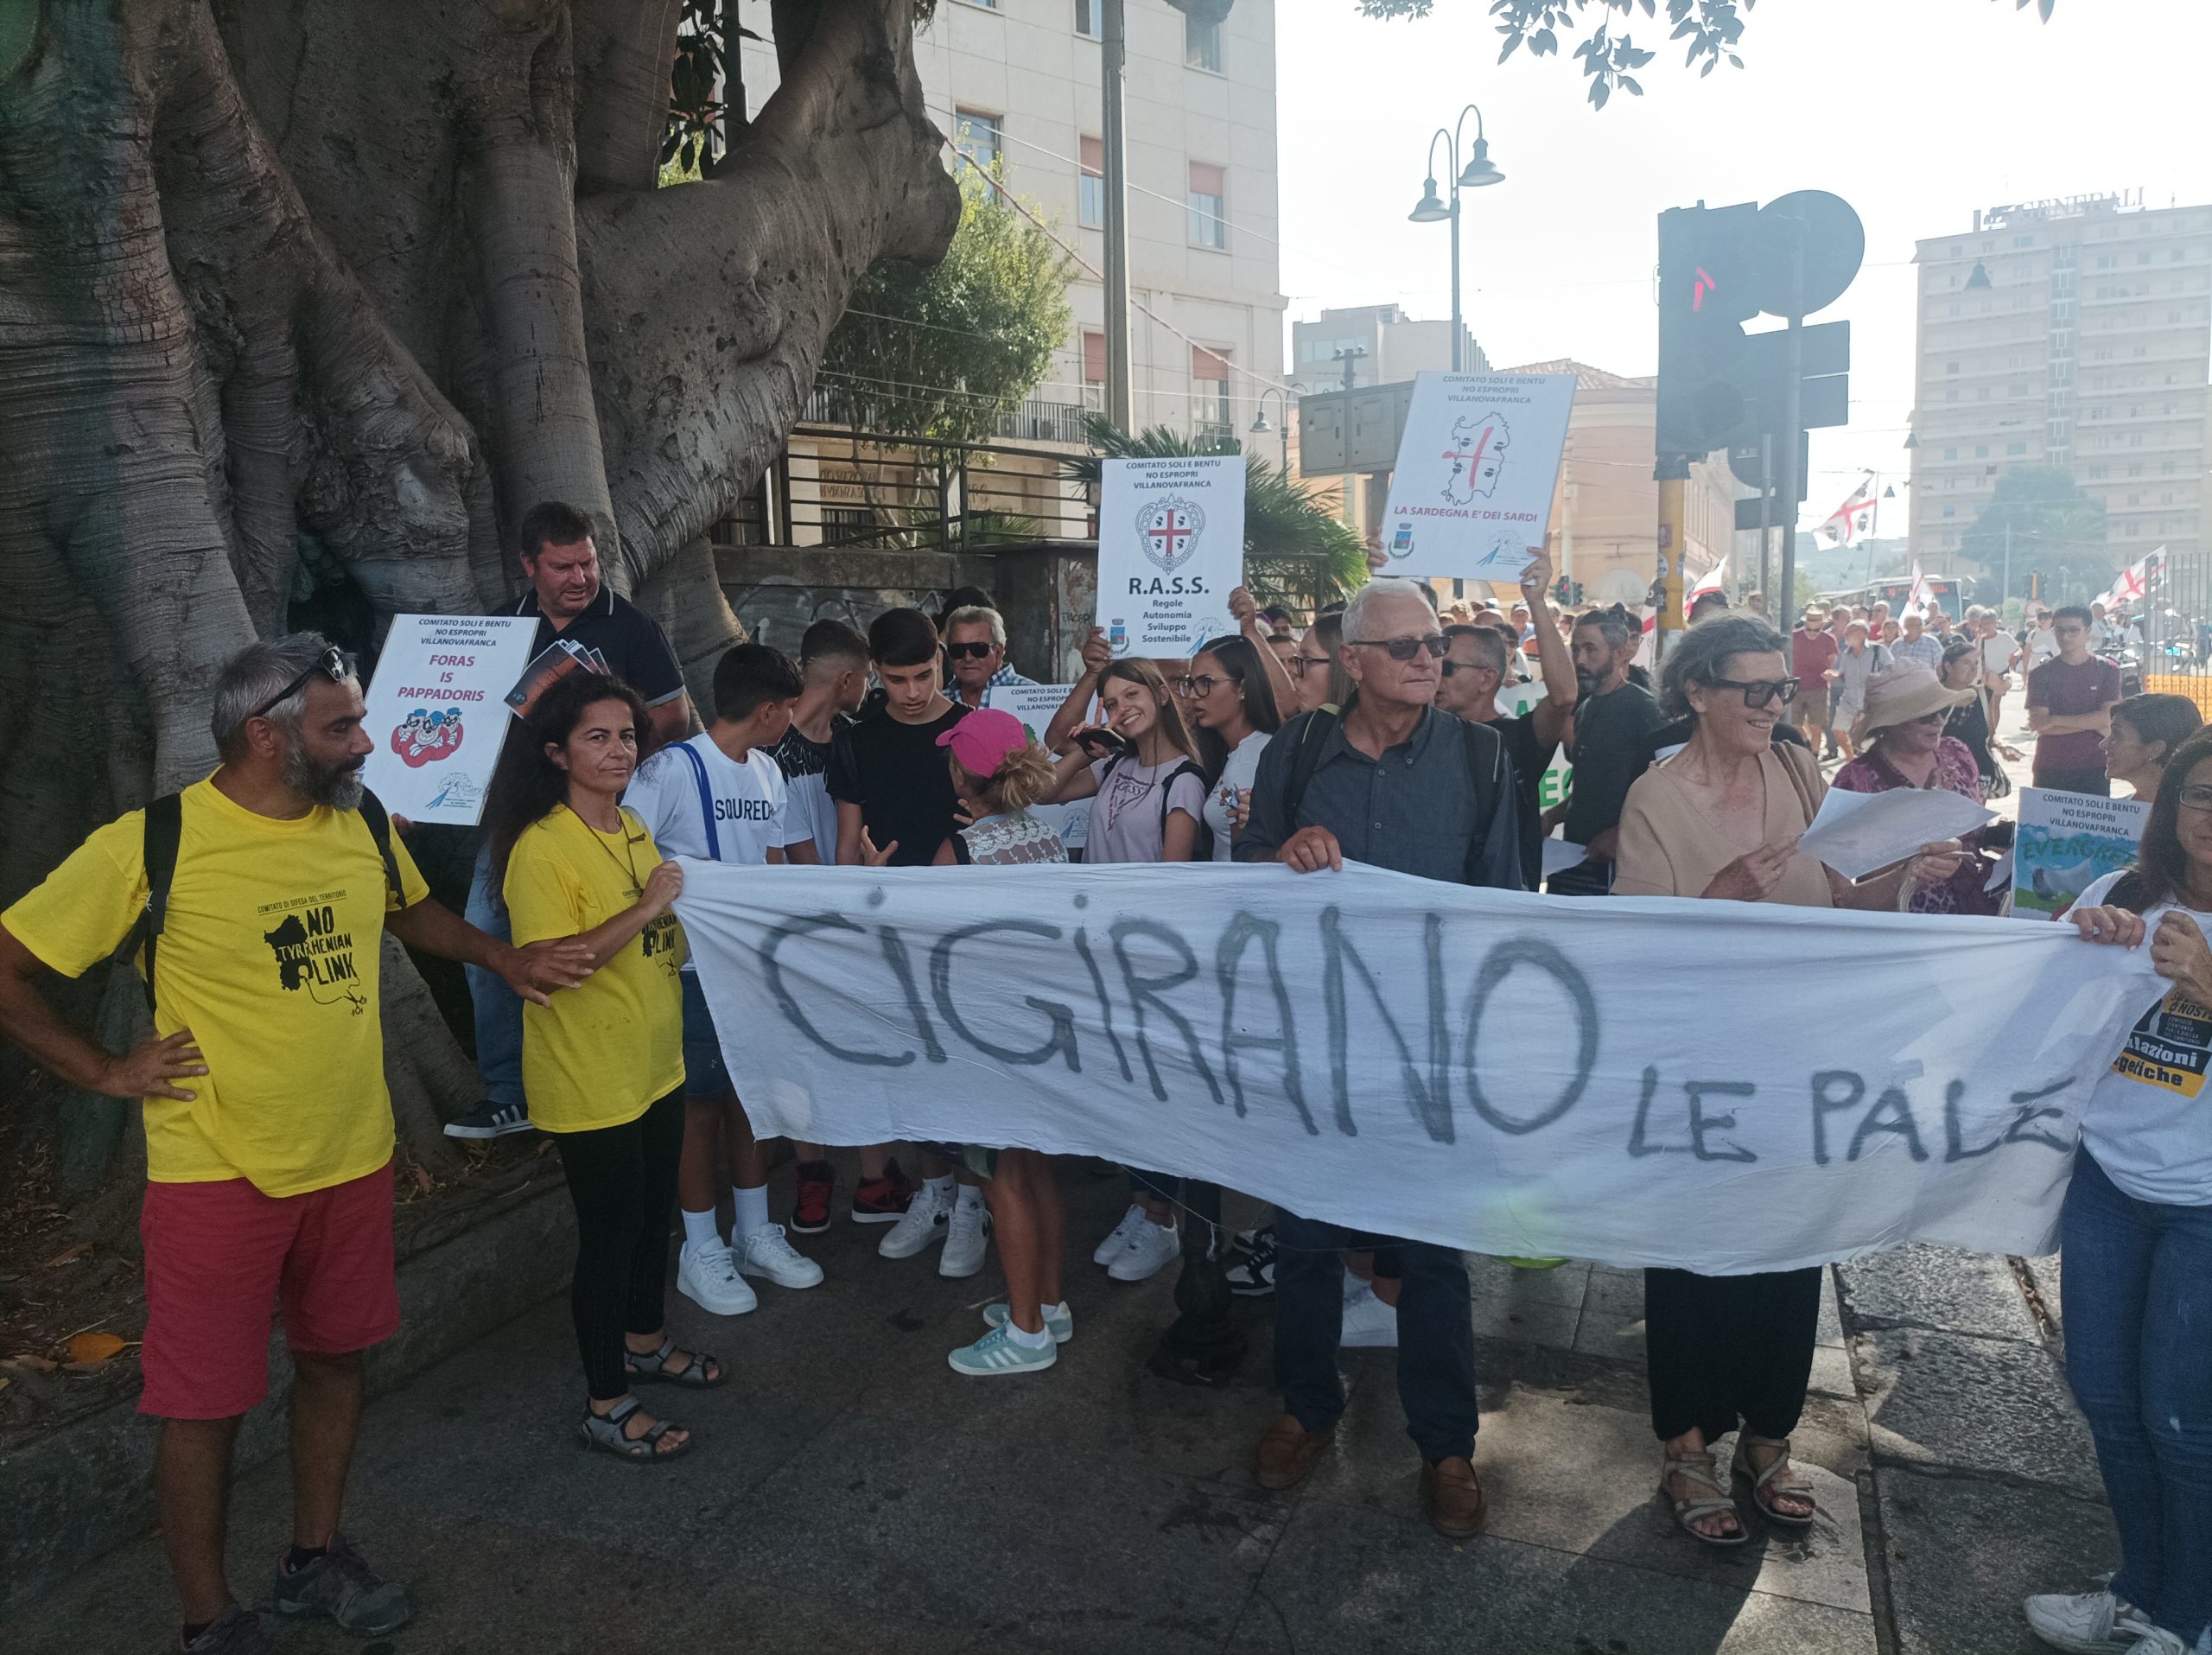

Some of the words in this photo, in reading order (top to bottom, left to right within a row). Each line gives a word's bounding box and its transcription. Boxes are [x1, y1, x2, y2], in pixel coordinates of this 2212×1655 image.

[1443, 375, 1486, 384] COMITATO
[1448, 395, 1531, 404] VILLANOVAFRANCA
[1134, 481, 1211, 489] VILLANOVAFRANCA
[1395, 506, 1408, 515] LA
[1410, 506, 1469, 519] SARDEGNA
[1483, 511, 1500, 520] DEI
[1503, 512, 1537, 522] SARDI
[1128, 576, 1210, 595] R.A.S.S.
[1153, 600, 1183, 610] Regole
[1147, 623, 1186, 633] Sviluppo
[420, 638, 496, 646] VILLANOVAFRANCA
[1142, 634, 1191, 643] Sostenibile
[429, 655, 475, 667] FORAS
[440, 672, 454, 684] IS
[397, 687, 484, 702] PAPPADORIS
[2043, 794, 2083, 805] COMITATO
[2086, 800, 2103, 809] SOLI
[2112, 804, 2139, 814] BENTU
[2076, 811, 2116, 822] ESPROPRI
[2050, 818, 2129, 836] VILLANOVAFRANCA
[257, 902, 283, 913] COMITATO
[290, 897, 308, 907] DIFESA
[319, 889, 346, 901] TERRITORIO
[306, 906, 334, 937] NO
[278, 933, 353, 961] TYRRHENIAN
[312, 952, 358, 985] LINK
[1628, 1065, 1757, 1162] LE
